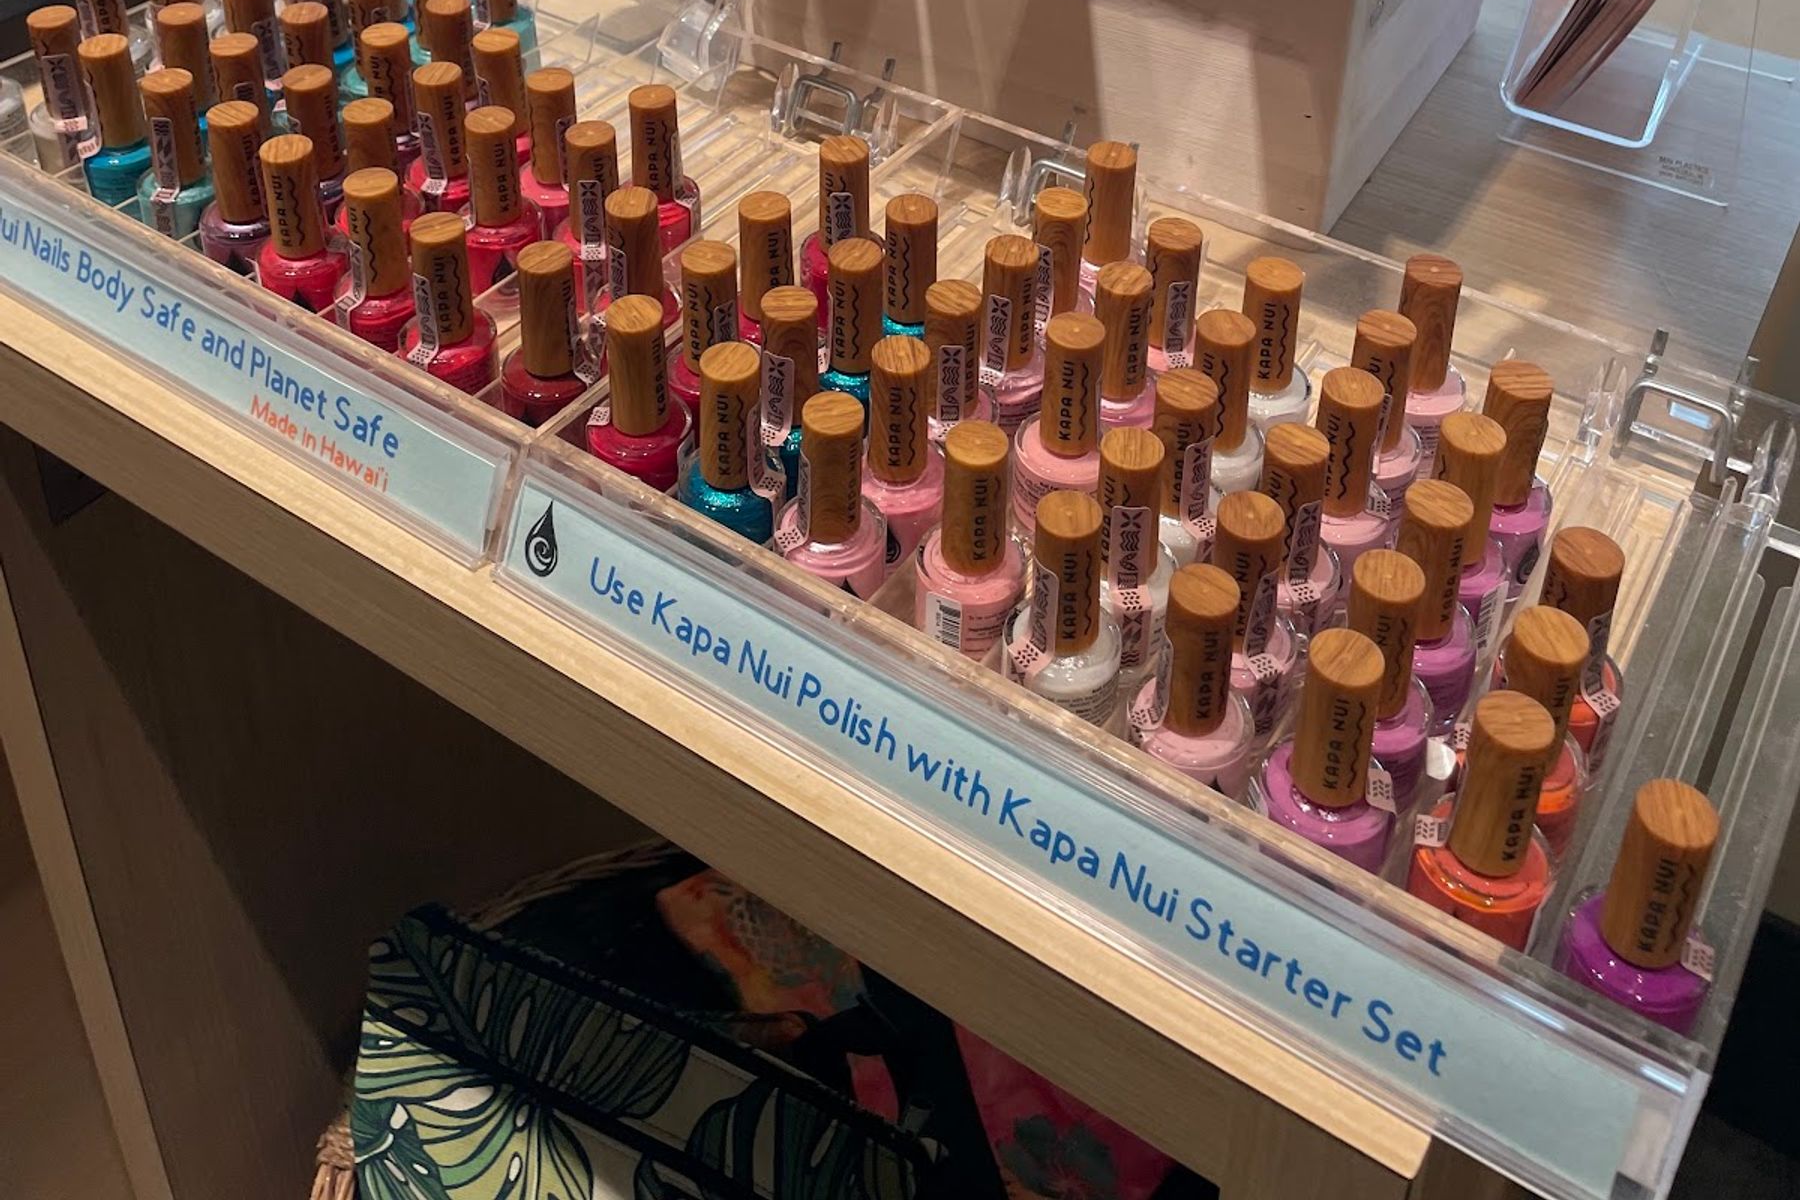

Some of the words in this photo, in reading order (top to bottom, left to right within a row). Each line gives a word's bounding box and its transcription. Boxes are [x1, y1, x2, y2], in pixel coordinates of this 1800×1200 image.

[272, 175, 283, 200] NUI
[275, 207, 293, 247] KAPA
[888, 231, 898, 258] NUI
[432, 257, 445, 283] NUI
[888, 266, 898, 306] KAPA
[436, 292, 450, 333] KAPA
[836, 281, 846, 308] NUI
[1264, 303, 1277, 330] NUI
[23, 224, 71, 274] Nails
[77, 250, 135, 312] Body
[141, 286, 197, 343] Safe
[201, 328, 245, 372] and
[250, 346, 327, 420] Planet
[335, 398, 400, 459] Safe
[835, 316, 845, 359] KAPA
[1062, 360, 1075, 389] NUI
[1258, 338, 1273, 379] KAPA
[717, 394, 729, 422] NUI
[888, 387, 900, 413] NUI
[1059, 397, 1072, 441] KAPA
[251, 395, 299, 442] Made
[301, 422, 318, 448] in
[718, 432, 730, 476] KAPA
[888, 423, 900, 467] KAPA
[975, 479, 987, 506] NUI
[973, 515, 986, 560] KAPA
[1064, 553, 1077, 583] NUI
[1062, 592, 1076, 639] KAPA
[1323, 742, 1342, 789] KAPA
[1334, 698, 1350, 730] NUI
[590, 557, 645, 614] Use
[651, 592, 731, 667] Kapa
[739, 639, 792, 700] Nui
[797, 671, 897, 761] Polish
[907, 743, 990, 815] with
[999, 787, 1100, 878] Kapa
[1110, 852, 1179, 923] Nui
[1186, 899, 1353, 1019] Starter
[1363, 1000, 1447, 1078] Set
[1502, 807, 1527, 861] KAPA
[1517, 766, 1535, 801] NUI
[1640, 902, 1666, 951] KAPA
[1653, 858, 1677, 893] NUI
